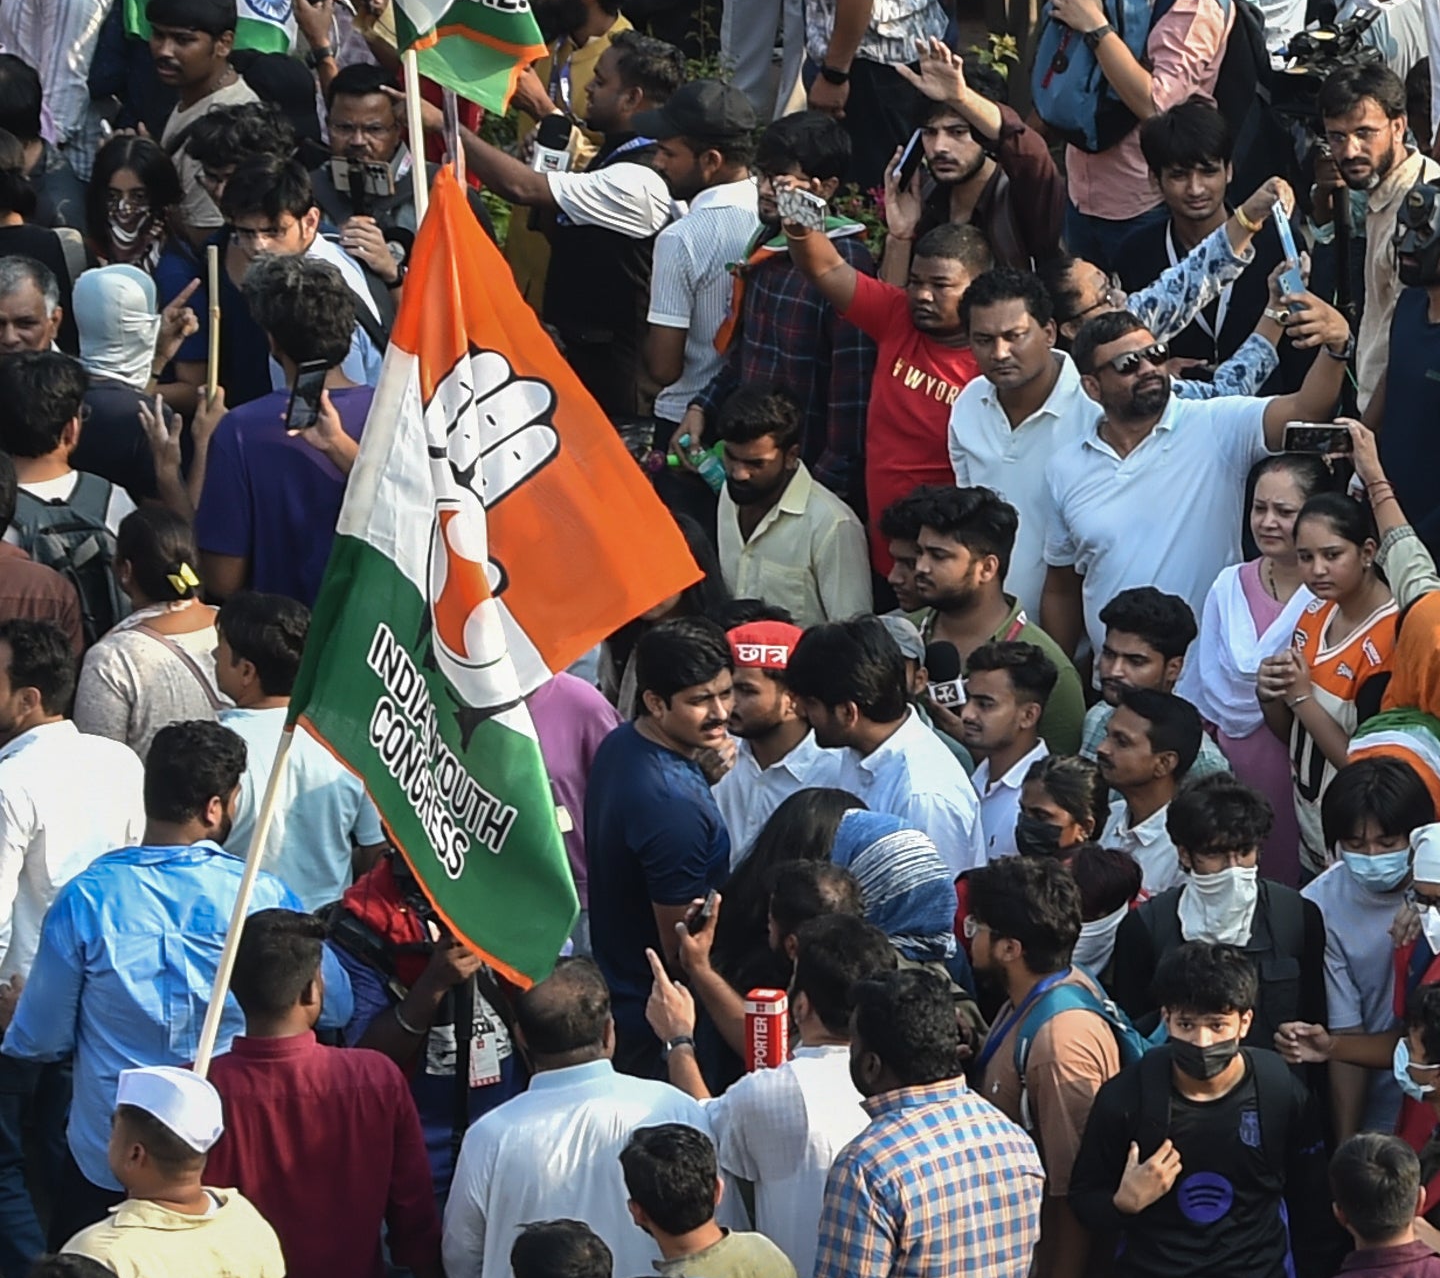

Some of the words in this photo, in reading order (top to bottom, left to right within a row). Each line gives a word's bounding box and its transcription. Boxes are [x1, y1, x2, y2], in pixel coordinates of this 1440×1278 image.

[735, 644, 788, 664] छात्र
[370, 696, 470, 879] CONGRESS
[754, 1016, 768, 1070] PORTER
